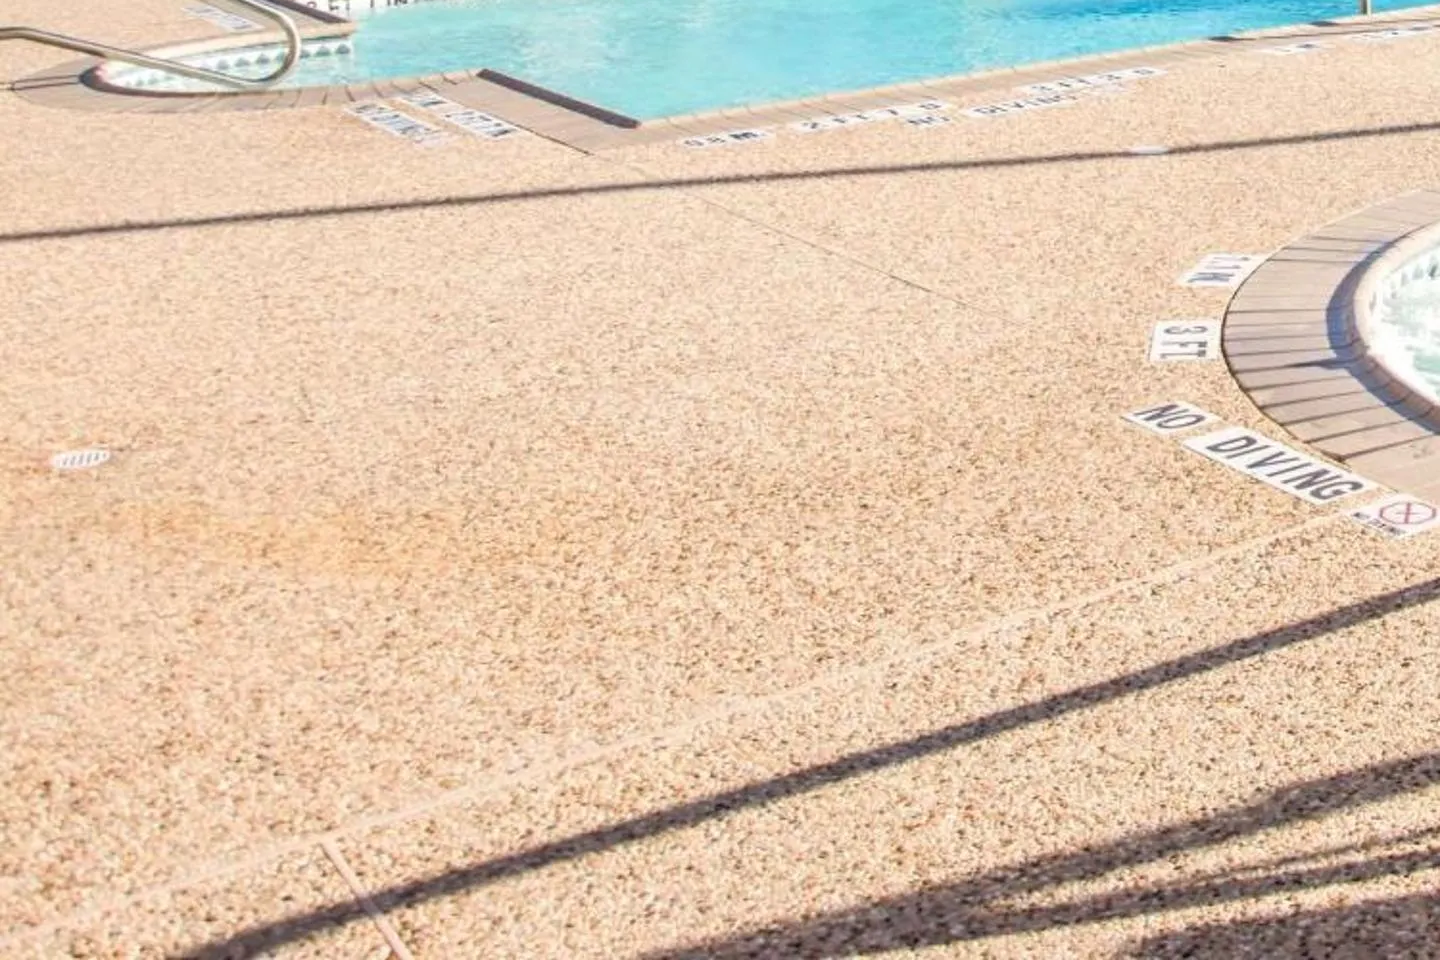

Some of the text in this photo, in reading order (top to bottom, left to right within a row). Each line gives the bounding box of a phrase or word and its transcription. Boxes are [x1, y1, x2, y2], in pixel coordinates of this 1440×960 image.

[1160, 325, 1209, 360] 3 FT
[1134, 403, 1206, 430] NO
[1205, 434, 1364, 501] DIVING
